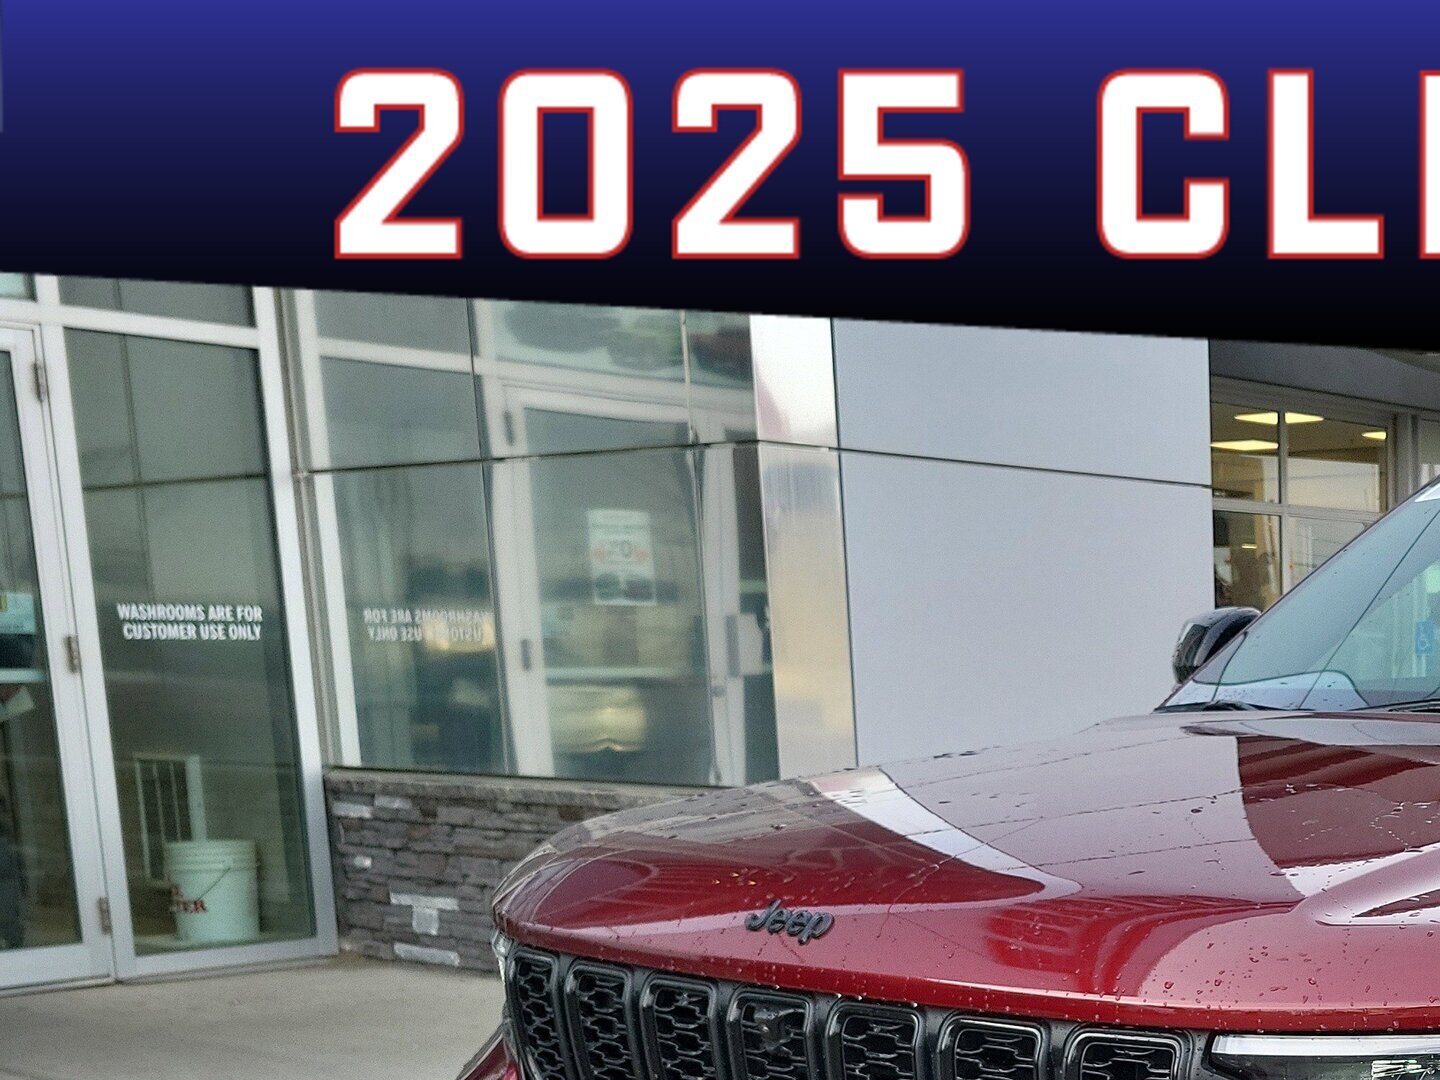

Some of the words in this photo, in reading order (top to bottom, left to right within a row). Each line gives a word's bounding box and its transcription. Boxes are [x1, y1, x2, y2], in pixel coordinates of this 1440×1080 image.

[116, 603, 206, 621] WASHROOMS
[207, 604, 235, 622] ARE
[236, 604, 263, 622] FOR
[123, 622, 197, 640] CUSTOMER
[199, 622, 227, 641] USE
[228, 622, 262, 641] ONLY
[744, 899, 835, 945] Jeep
